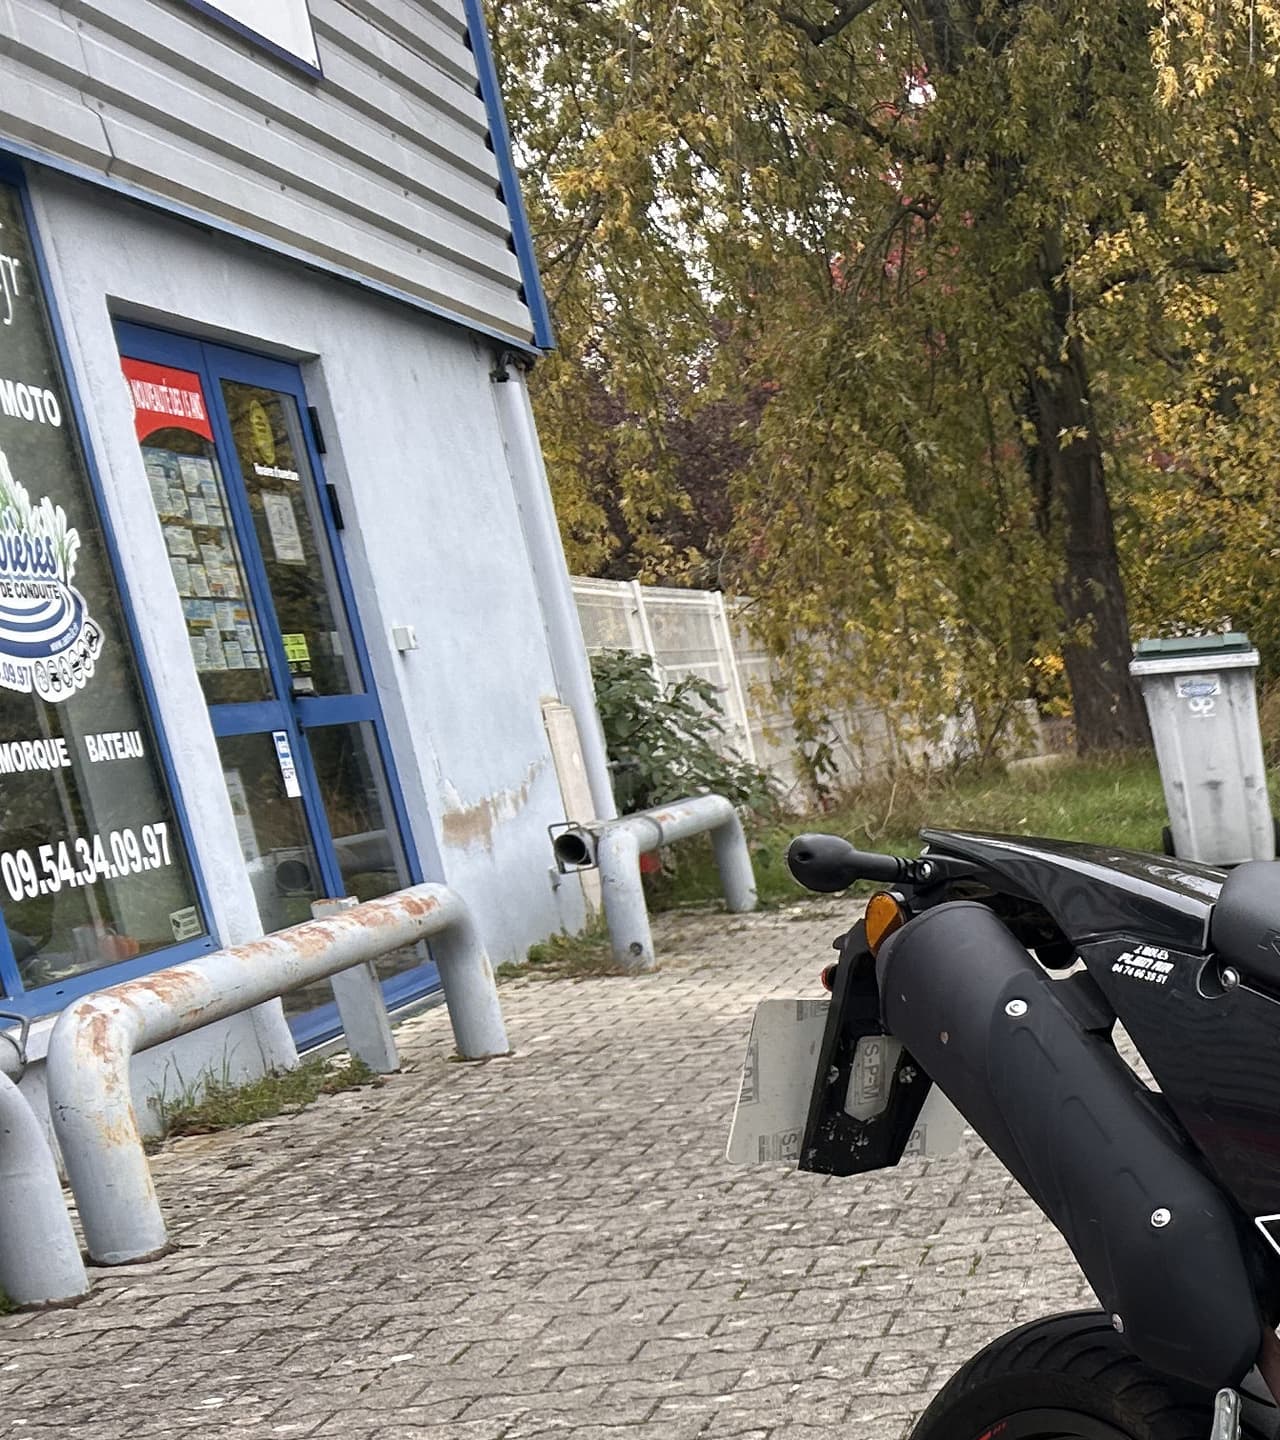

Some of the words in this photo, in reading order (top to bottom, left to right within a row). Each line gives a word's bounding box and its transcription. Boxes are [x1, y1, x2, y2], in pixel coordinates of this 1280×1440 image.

[15, 582, 60, 600] CONDUITE
[84, 731, 144, 763] BATEAU
[1, 822, 171, 901] 09.54.34.09.97
[863, 1043, 880, 1100] S-P-M
